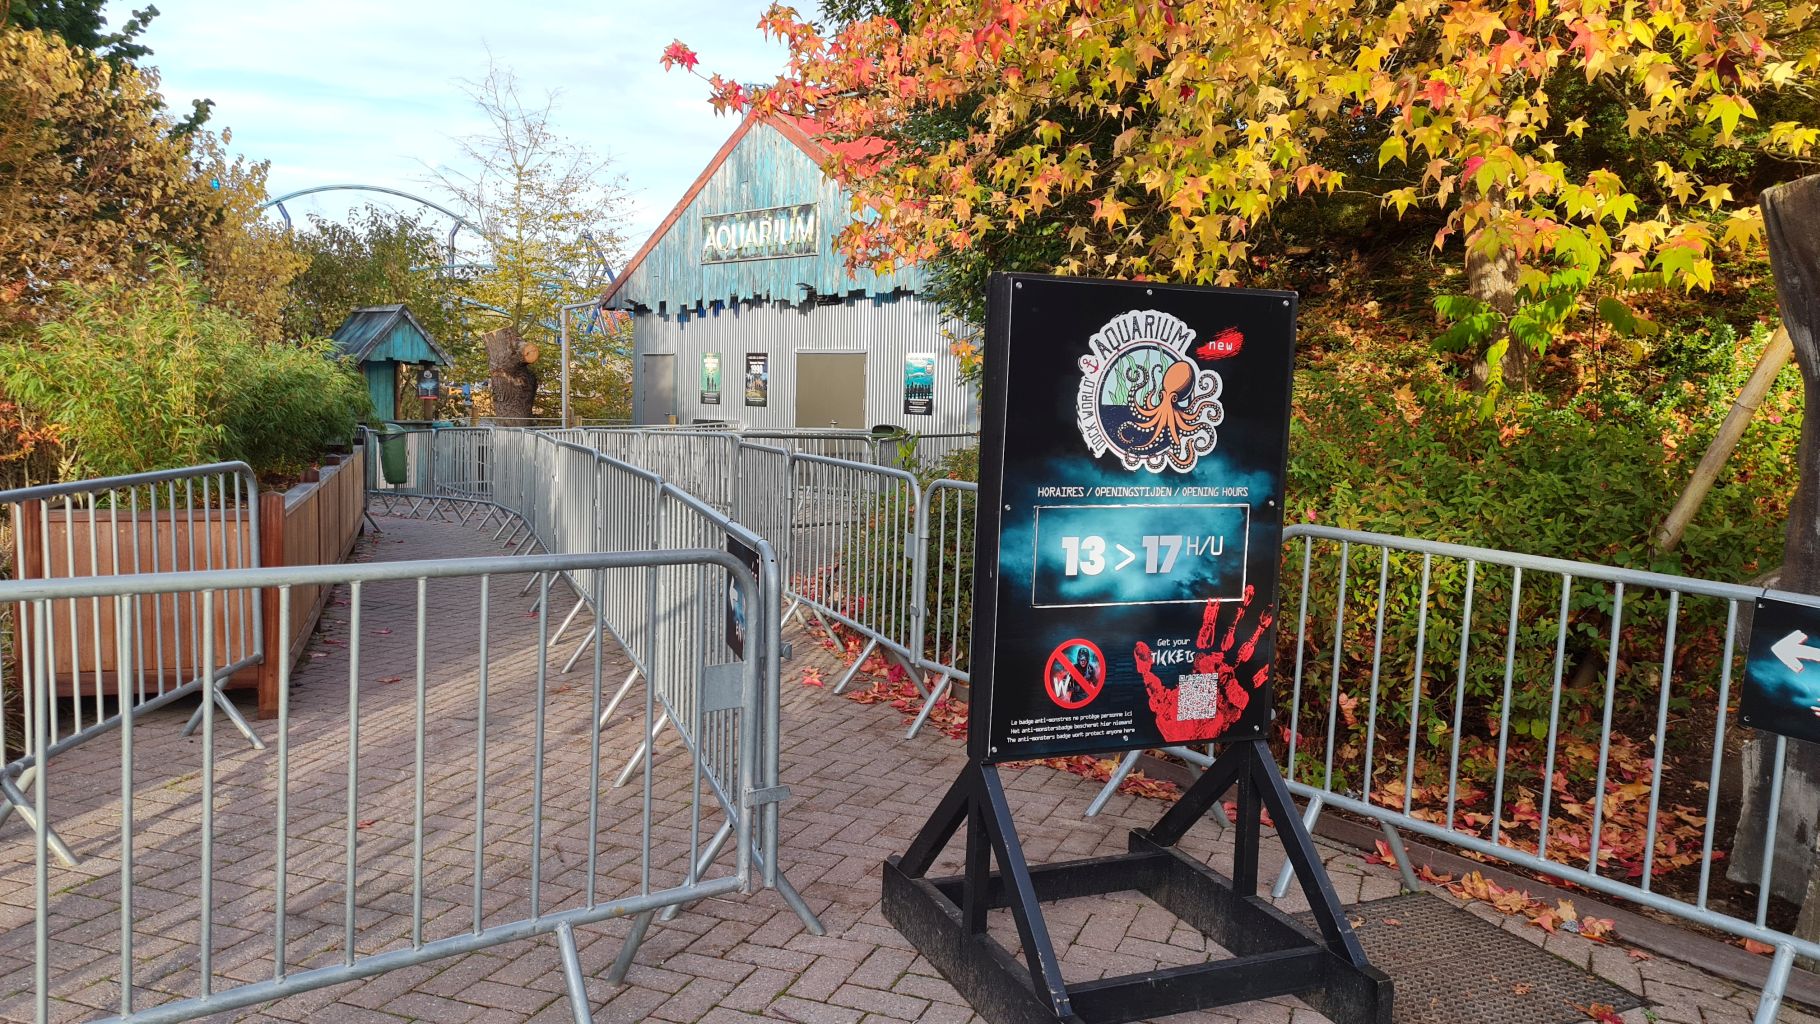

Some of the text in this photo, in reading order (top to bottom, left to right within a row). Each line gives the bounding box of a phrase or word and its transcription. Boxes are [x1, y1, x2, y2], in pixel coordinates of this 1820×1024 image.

[703, 213, 815, 256] AQUARIUM
[1094, 314, 1191, 360] AQUARIUM
[1208, 340, 1234, 351] new
[1085, 425, 1106, 451] DOCK
[1037, 486, 1085, 498] HORAIRES
[1094, 486, 1173, 497] OPENINGSTIJDEN
[1182, 486, 1219, 497] OPENING
[1222, 486, 1249, 497] HOURS
[1061, 535, 1106, 576] 13
[1142, 534, 1183, 574] 17
[1186, 535, 1224, 556] H/U
[1157, 638, 1191, 648] Get your
[1151, 649, 1195, 667] TICKETS
[1056, 732, 1072, 740] badge
